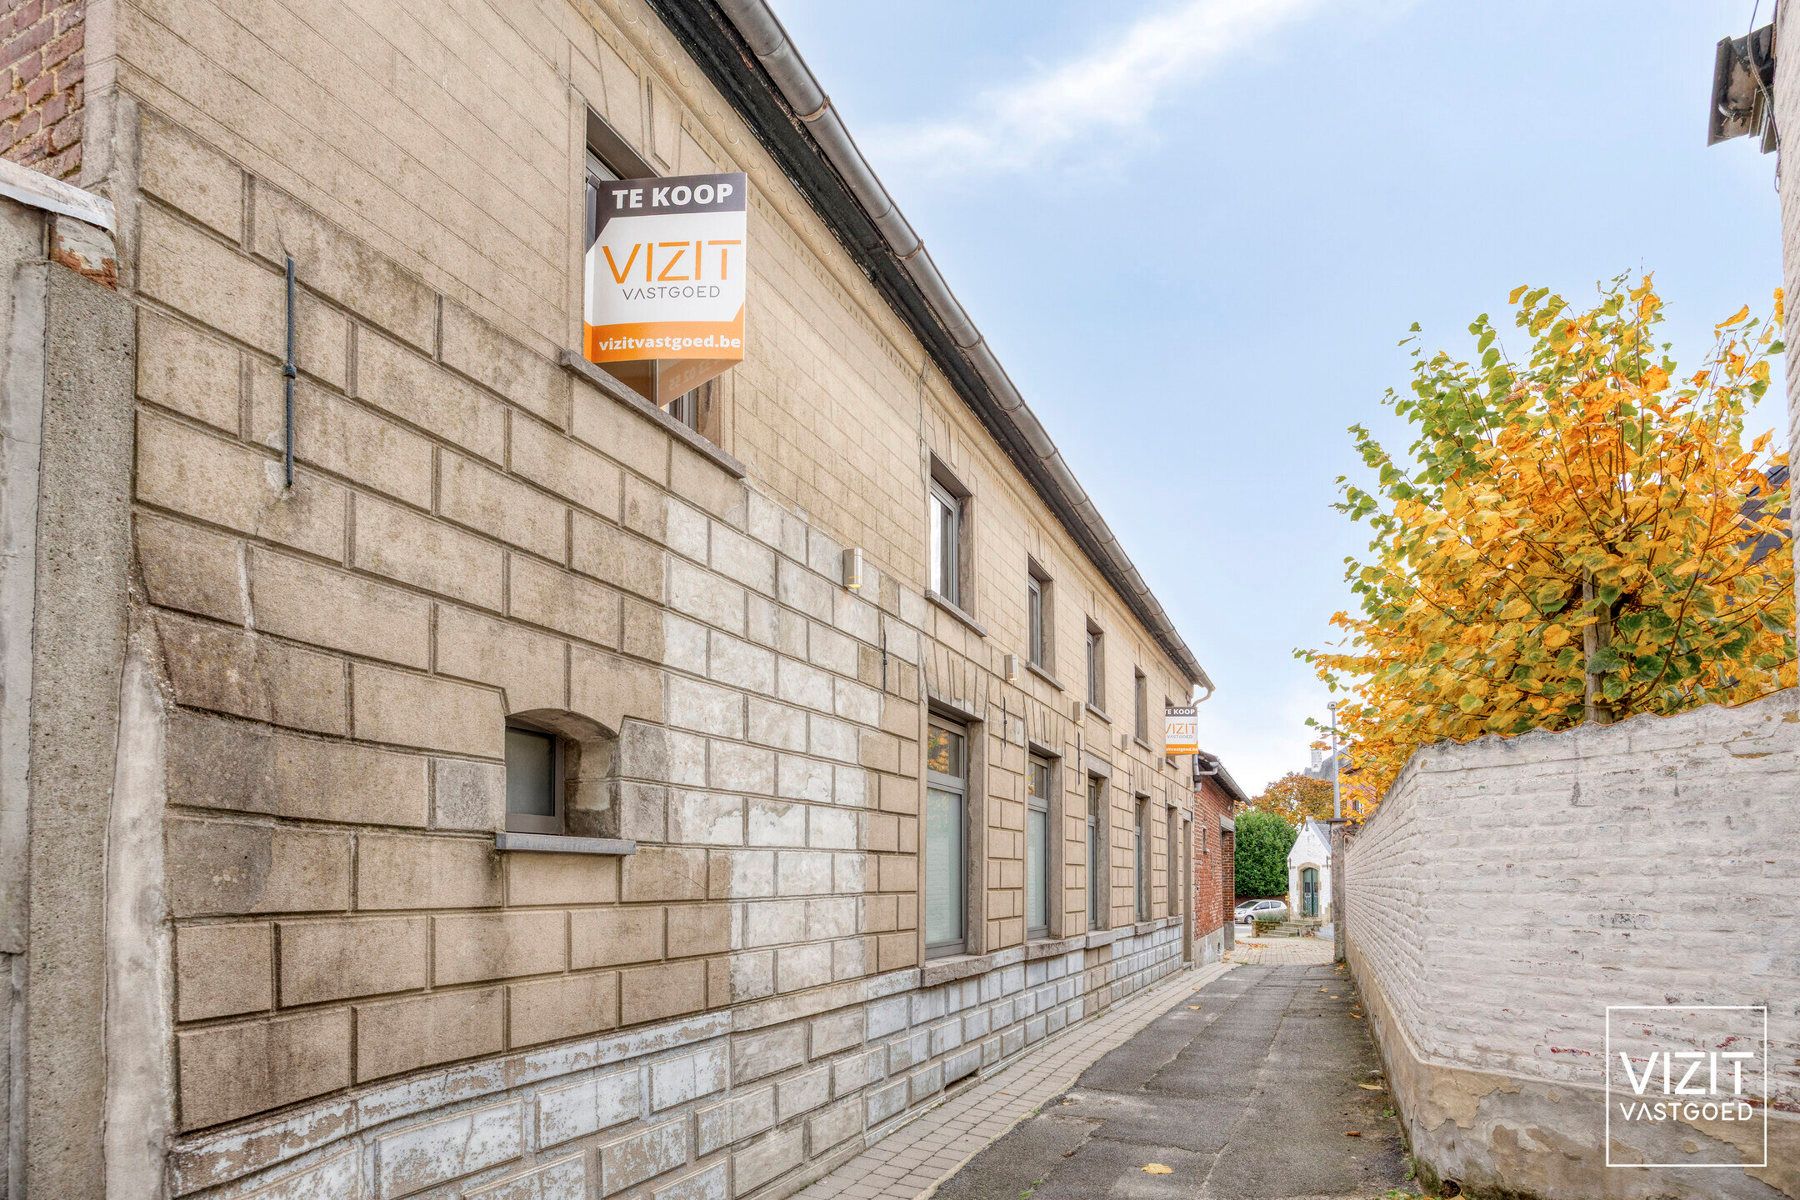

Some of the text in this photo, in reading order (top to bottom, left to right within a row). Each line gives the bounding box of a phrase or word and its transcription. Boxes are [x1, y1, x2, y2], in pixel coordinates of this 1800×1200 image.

[611, 183, 734, 210] TE KOOP
[602, 240, 742, 285] VIZIT
[622, 285, 721, 301] VASTGOED
[599, 334, 741, 352] vizitvastgoed.be
